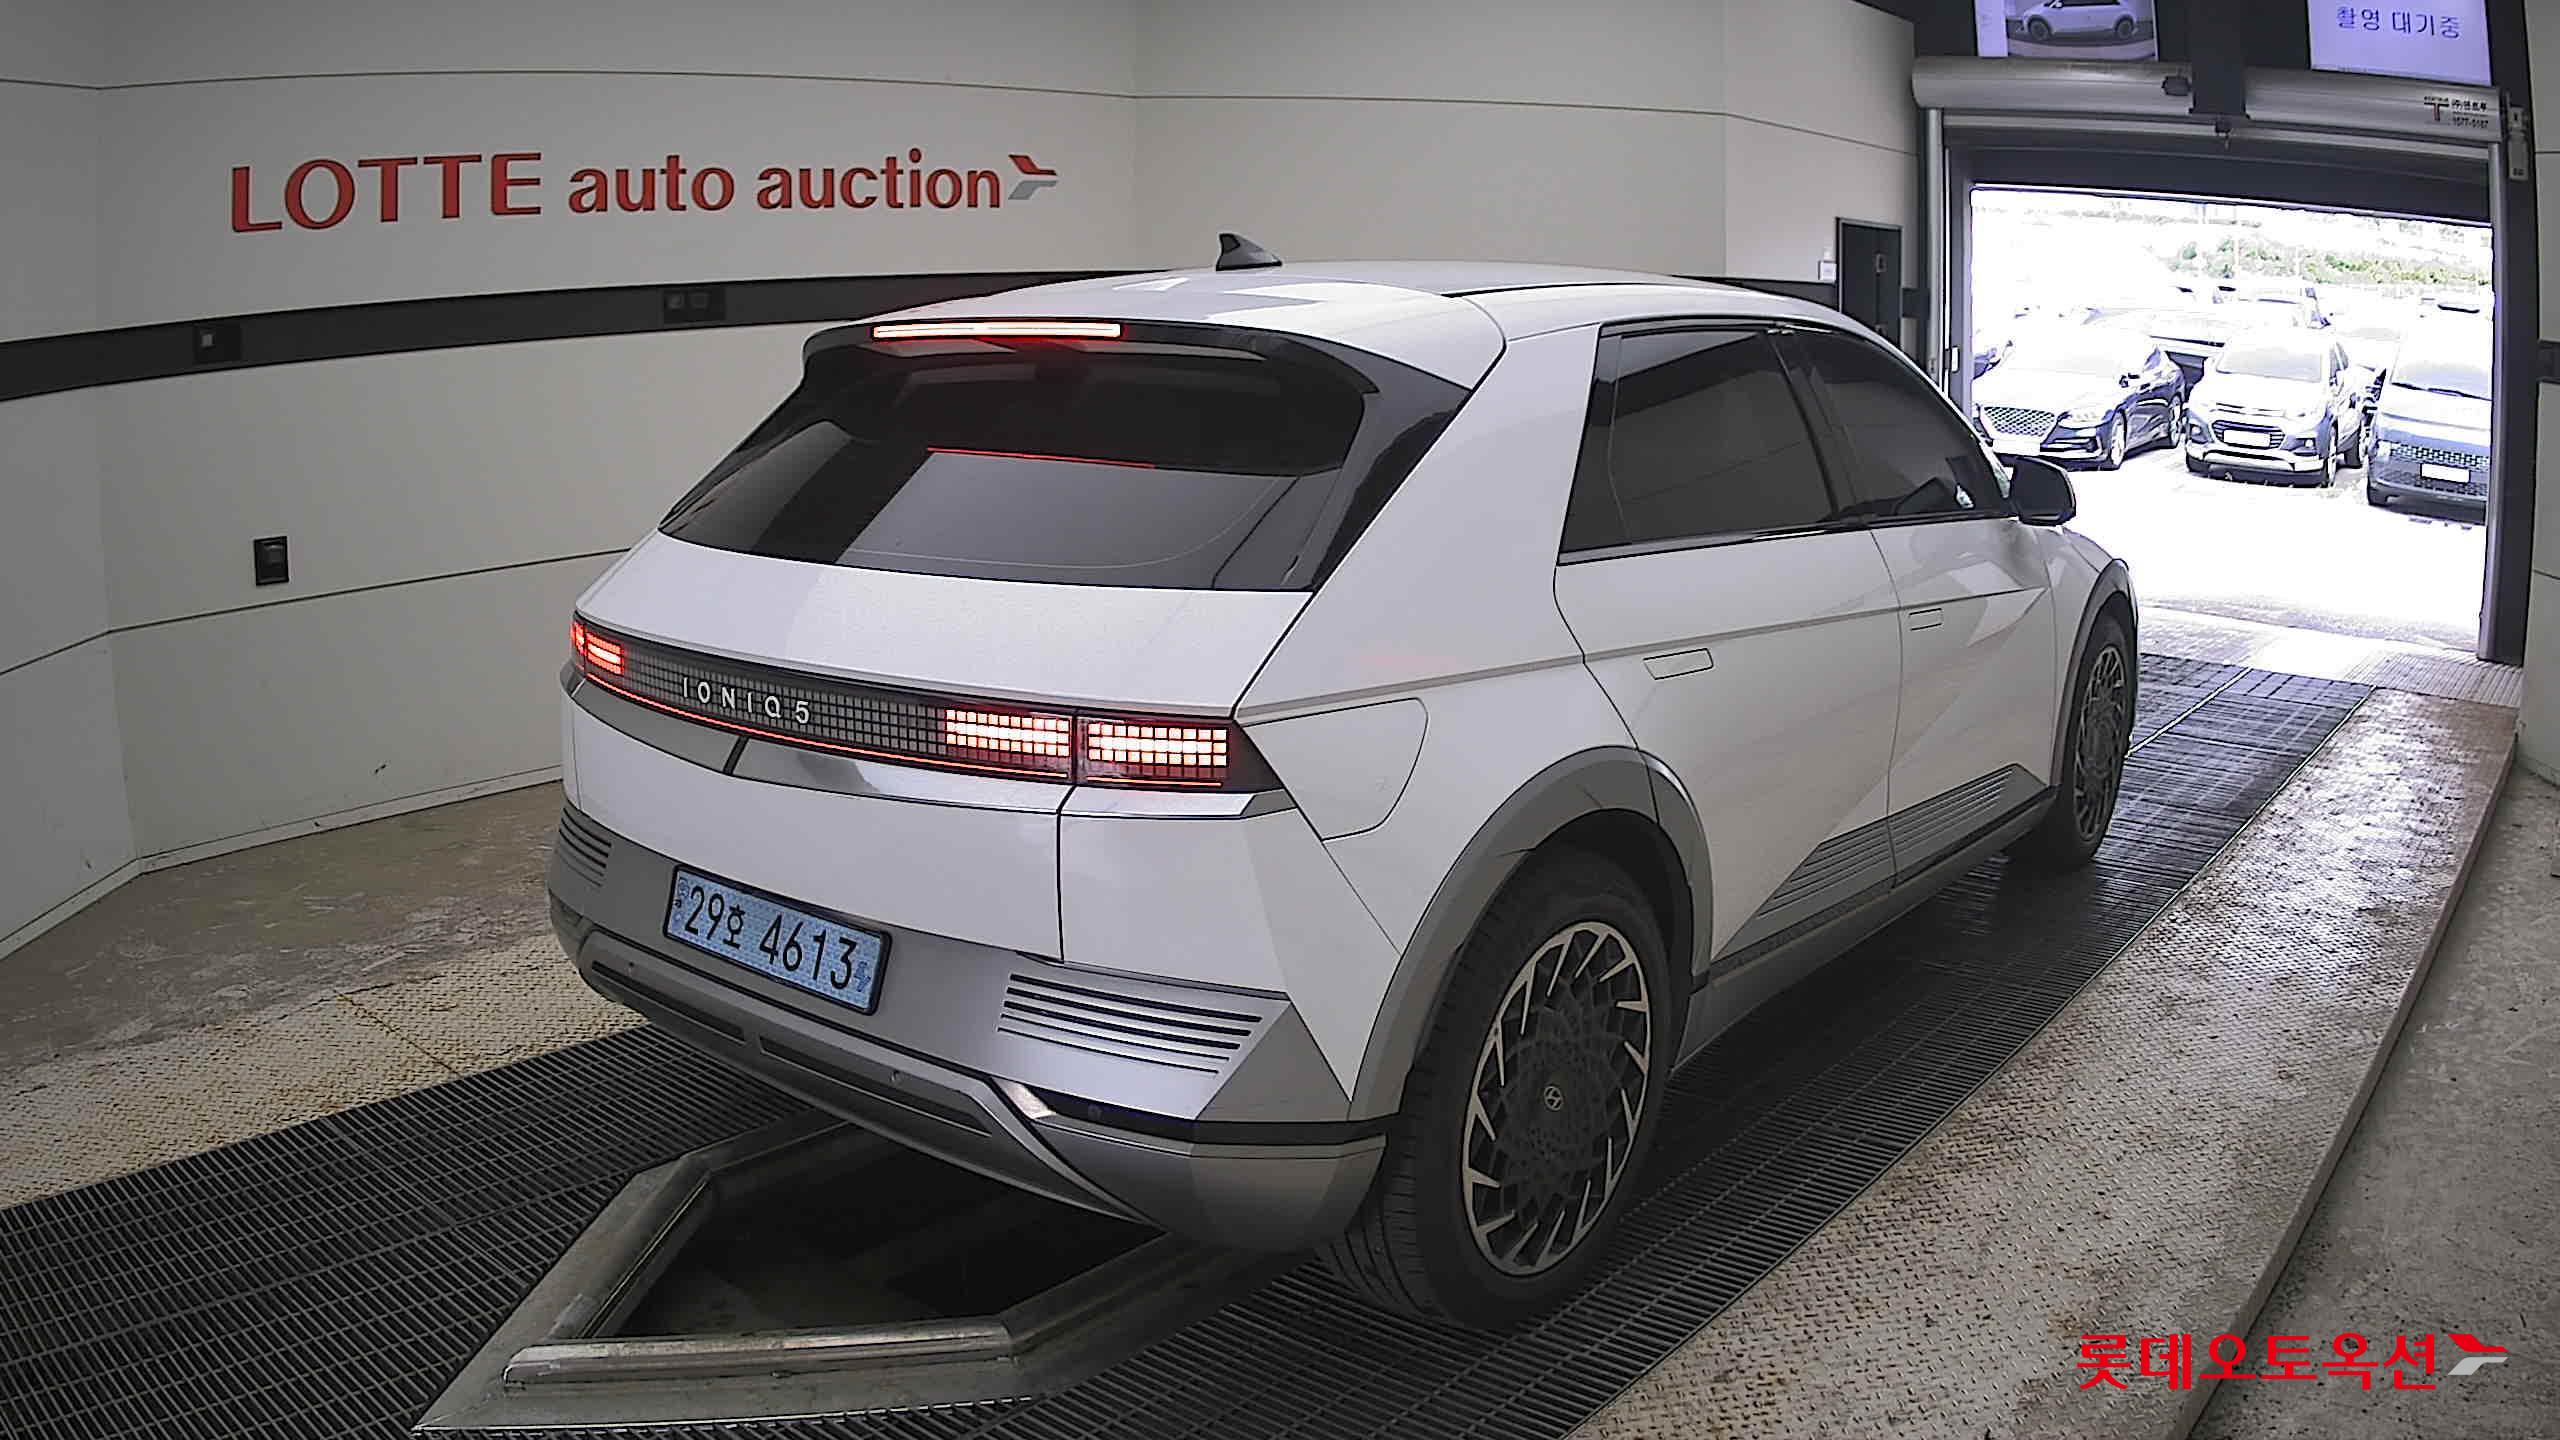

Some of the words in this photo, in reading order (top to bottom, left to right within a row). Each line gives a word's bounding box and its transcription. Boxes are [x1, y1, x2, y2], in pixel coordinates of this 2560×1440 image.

[2337, 6, 2380, 32] 촬영
[2392, 10, 2461, 40] 대기중
[231, 153, 541, 233] LOTTE
[569, 156, 735, 213] auto
[757, 149, 1001, 209] auction
[684, 884, 746, 950] 29호
[758, 913, 858, 990] 4613
